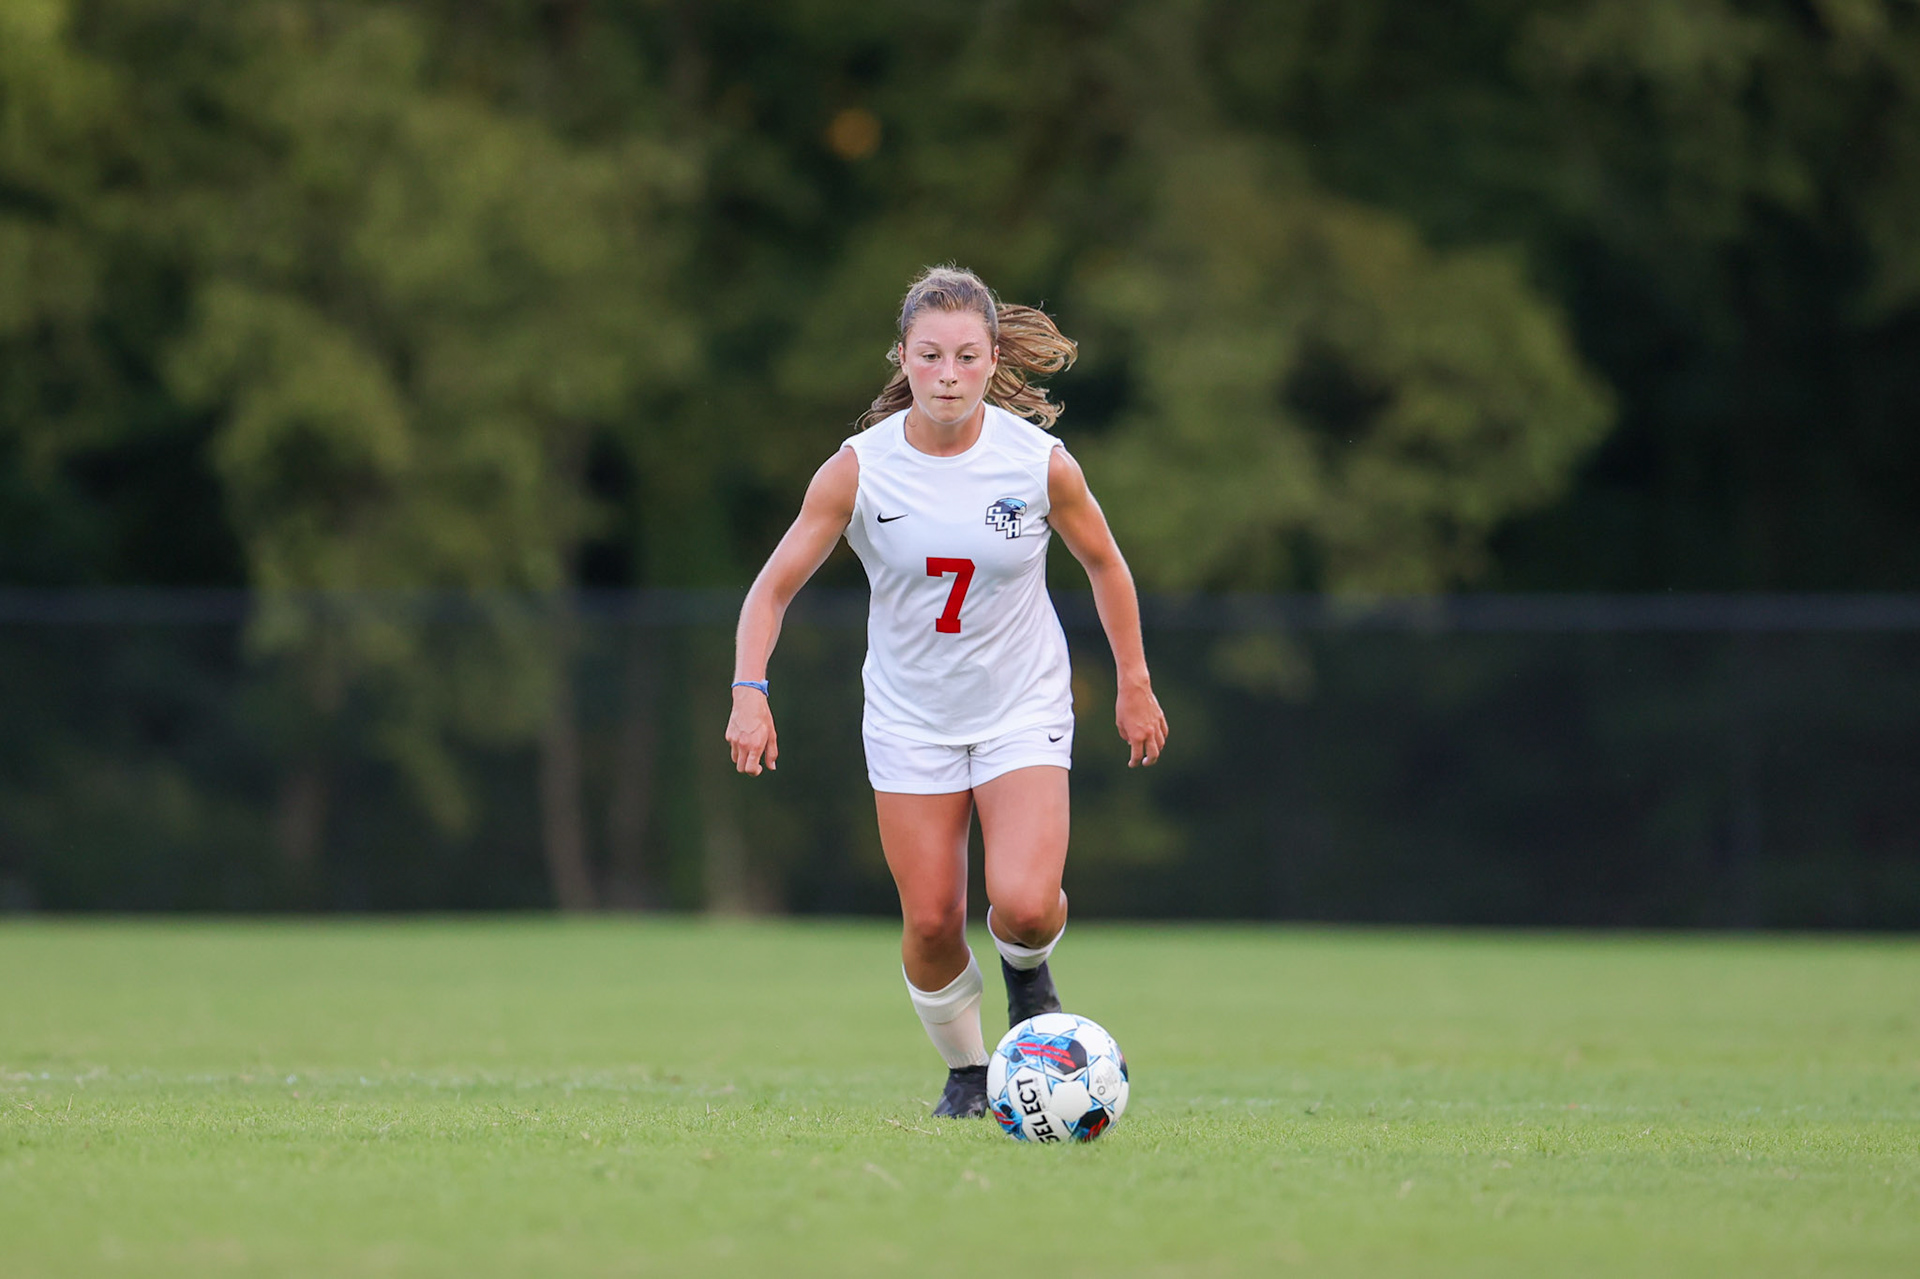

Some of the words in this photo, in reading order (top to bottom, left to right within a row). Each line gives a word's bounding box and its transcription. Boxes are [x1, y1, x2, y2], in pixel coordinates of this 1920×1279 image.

[986, 505, 1020, 538] SBA
[926, 557, 976, 633] 7
[1016, 1078, 1060, 1144] SELECT
